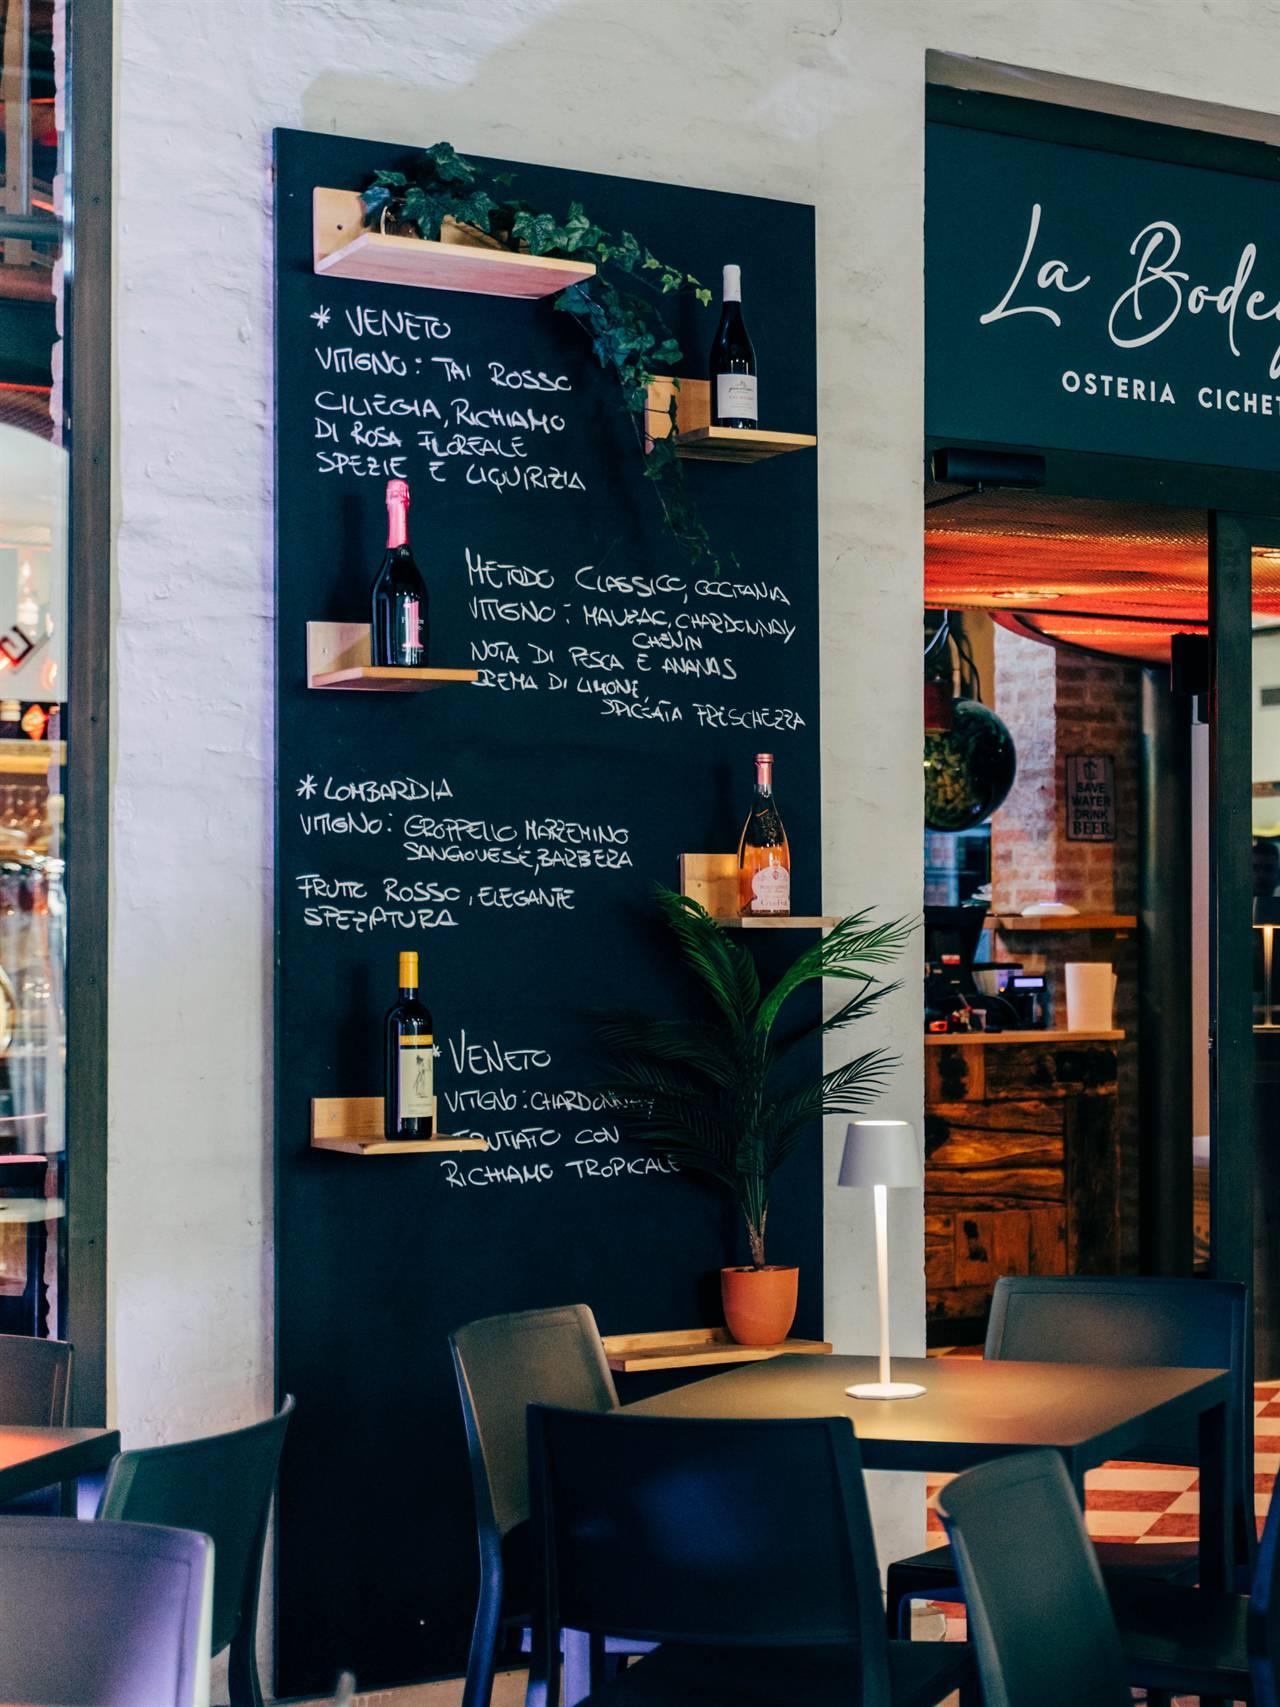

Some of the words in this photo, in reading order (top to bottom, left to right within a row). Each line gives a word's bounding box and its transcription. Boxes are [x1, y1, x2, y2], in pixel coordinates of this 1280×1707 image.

[979, 203, 1090, 327] La
[345, 304, 451, 340] VENETO
[431, 356, 471, 382] TAI
[488, 362, 572, 391] ROSSO
[1061, 370, 1176, 405] OSTERIA
[451, 399, 566, 434] RICHIAMO
[314, 417, 339, 442] DI
[350, 421, 402, 448] ROSA
[417, 430, 528, 457] FLOREALE
[316, 451, 408, 478] SPEZIE
[429, 461, 446, 482] E
[465, 547, 554, 589] METODO
[675, 611, 797, 644] CHARDONNAY
[471, 641, 519, 664] NOTA
[527, 643, 554, 664] DI
[568, 646, 624, 671] PESCA
[637, 652, 652, 671] E
[662, 657, 737, 680] ANANAS
[548, 672, 567, 690] DI
[324, 776, 454, 802] LOMBARDIA
[1072, 796, 1111, 807] WATER
[1076, 783, 1105, 793] SAVE
[404, 815, 518, 842] GROPPELLO
[1073, 822, 1111, 835] BEER
[1074, 809, 1108, 820] DRINK
[535, 848, 634, 869] BARBERA
[448, 1028, 551, 1075] VENETO
[574, 1126, 620, 1146] CON
[440, 1160, 554, 1188] RICHIAMO
